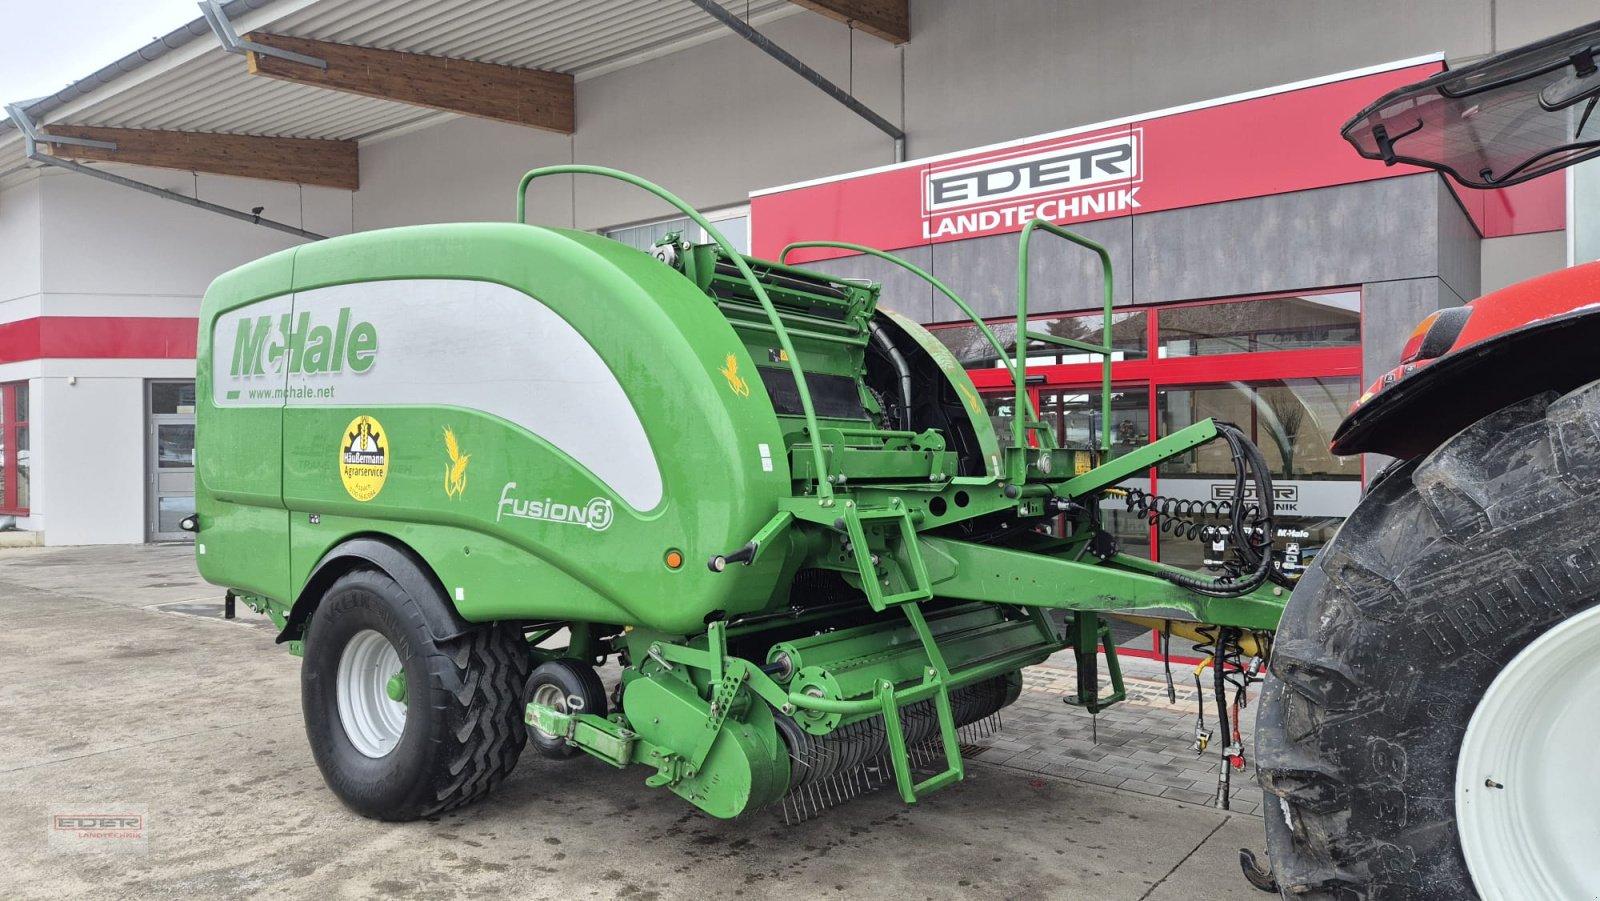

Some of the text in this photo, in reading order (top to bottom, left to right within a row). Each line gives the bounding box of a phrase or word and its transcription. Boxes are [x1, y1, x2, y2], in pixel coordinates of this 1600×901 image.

[930, 143, 1132, 204] EDER
[922, 187, 1142, 239] LANDTECHNIK
[230, 308, 378, 377] McHale
[248, 385, 335, 399] www.mchale.net
[344, 452, 384, 465] Häußermann
[344, 466, 384, 478] Agrarservice
